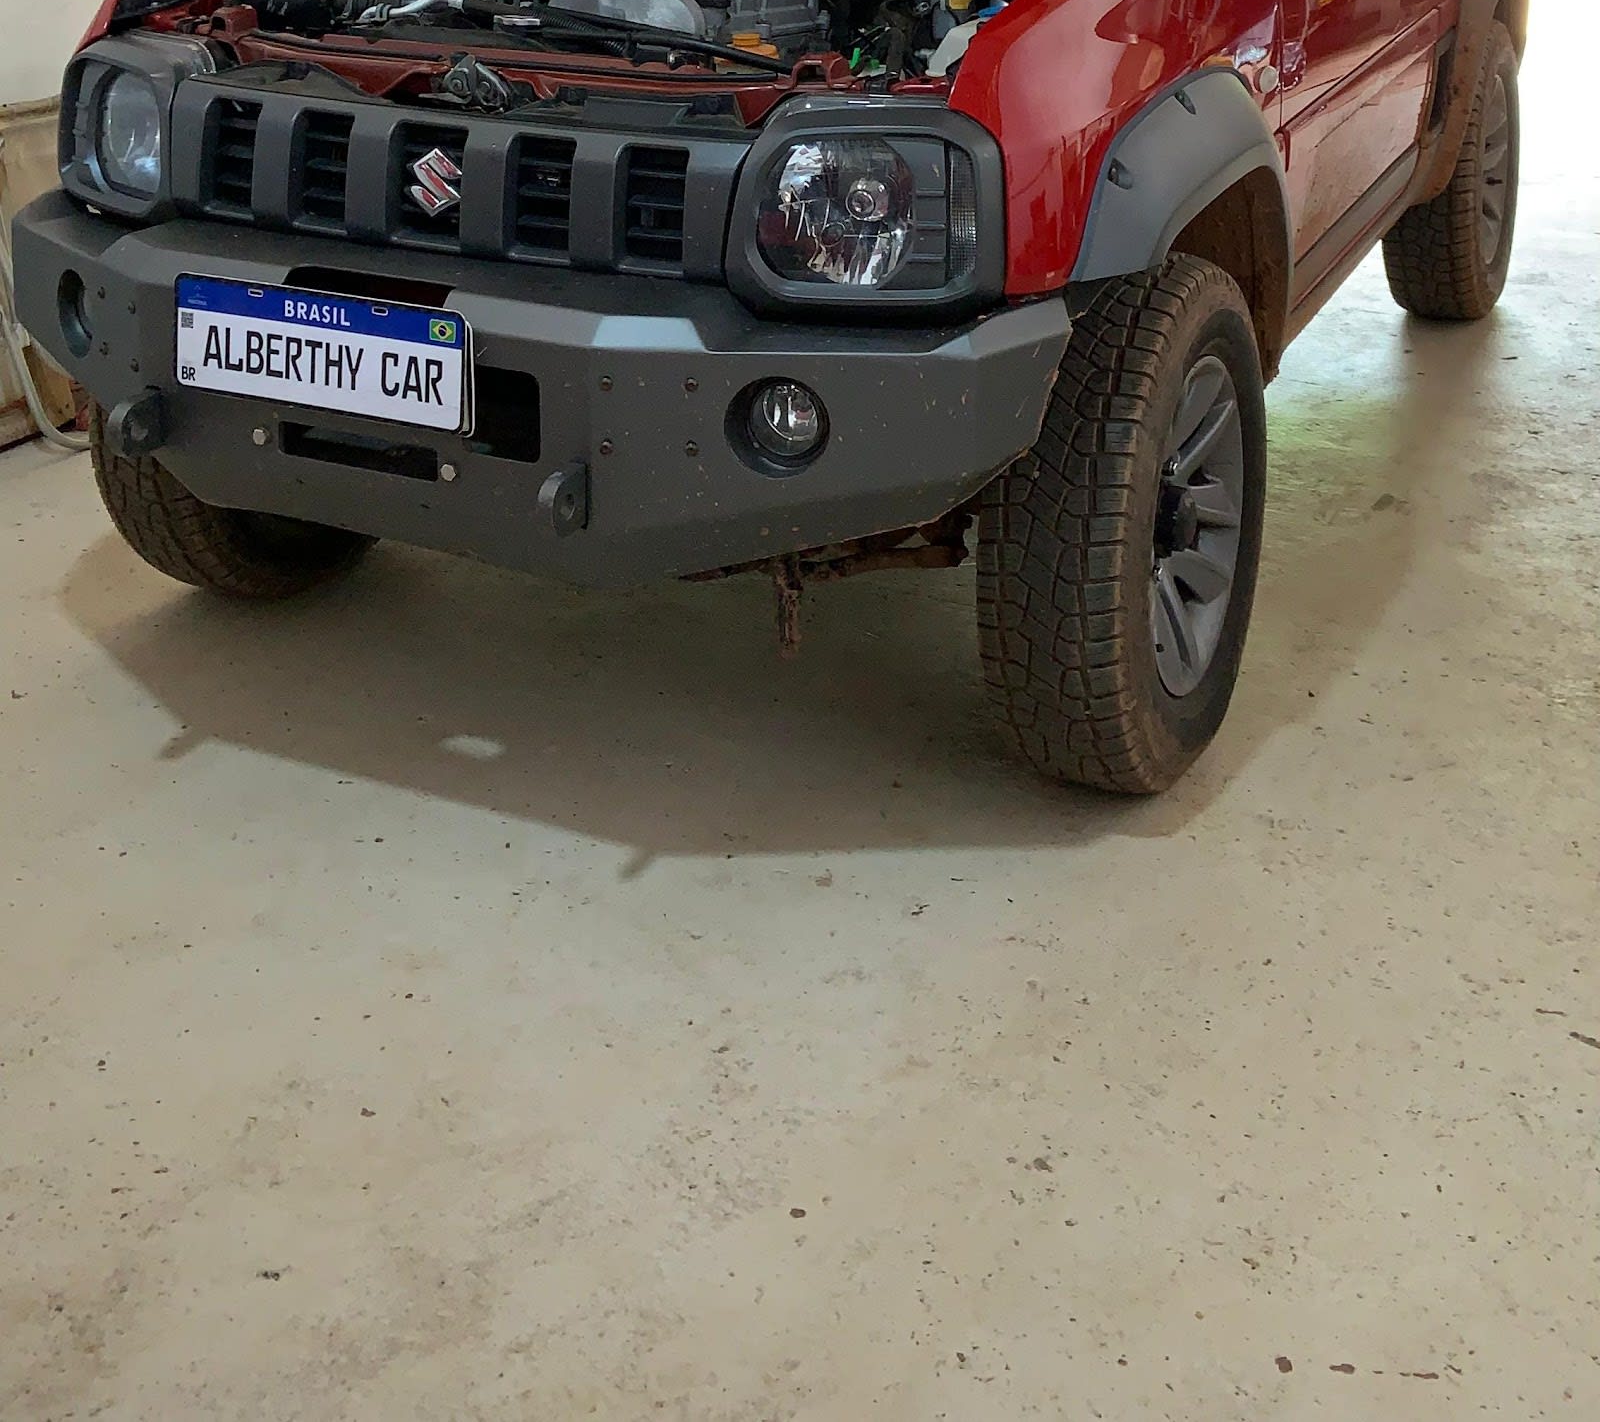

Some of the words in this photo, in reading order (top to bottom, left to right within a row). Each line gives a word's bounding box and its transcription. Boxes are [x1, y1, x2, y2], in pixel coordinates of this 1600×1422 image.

[284, 299, 351, 327] BRASIL
[181, 366, 196, 381] BR
[203, 325, 364, 391] ALBERTHY
[381, 351, 444, 406] CAR
